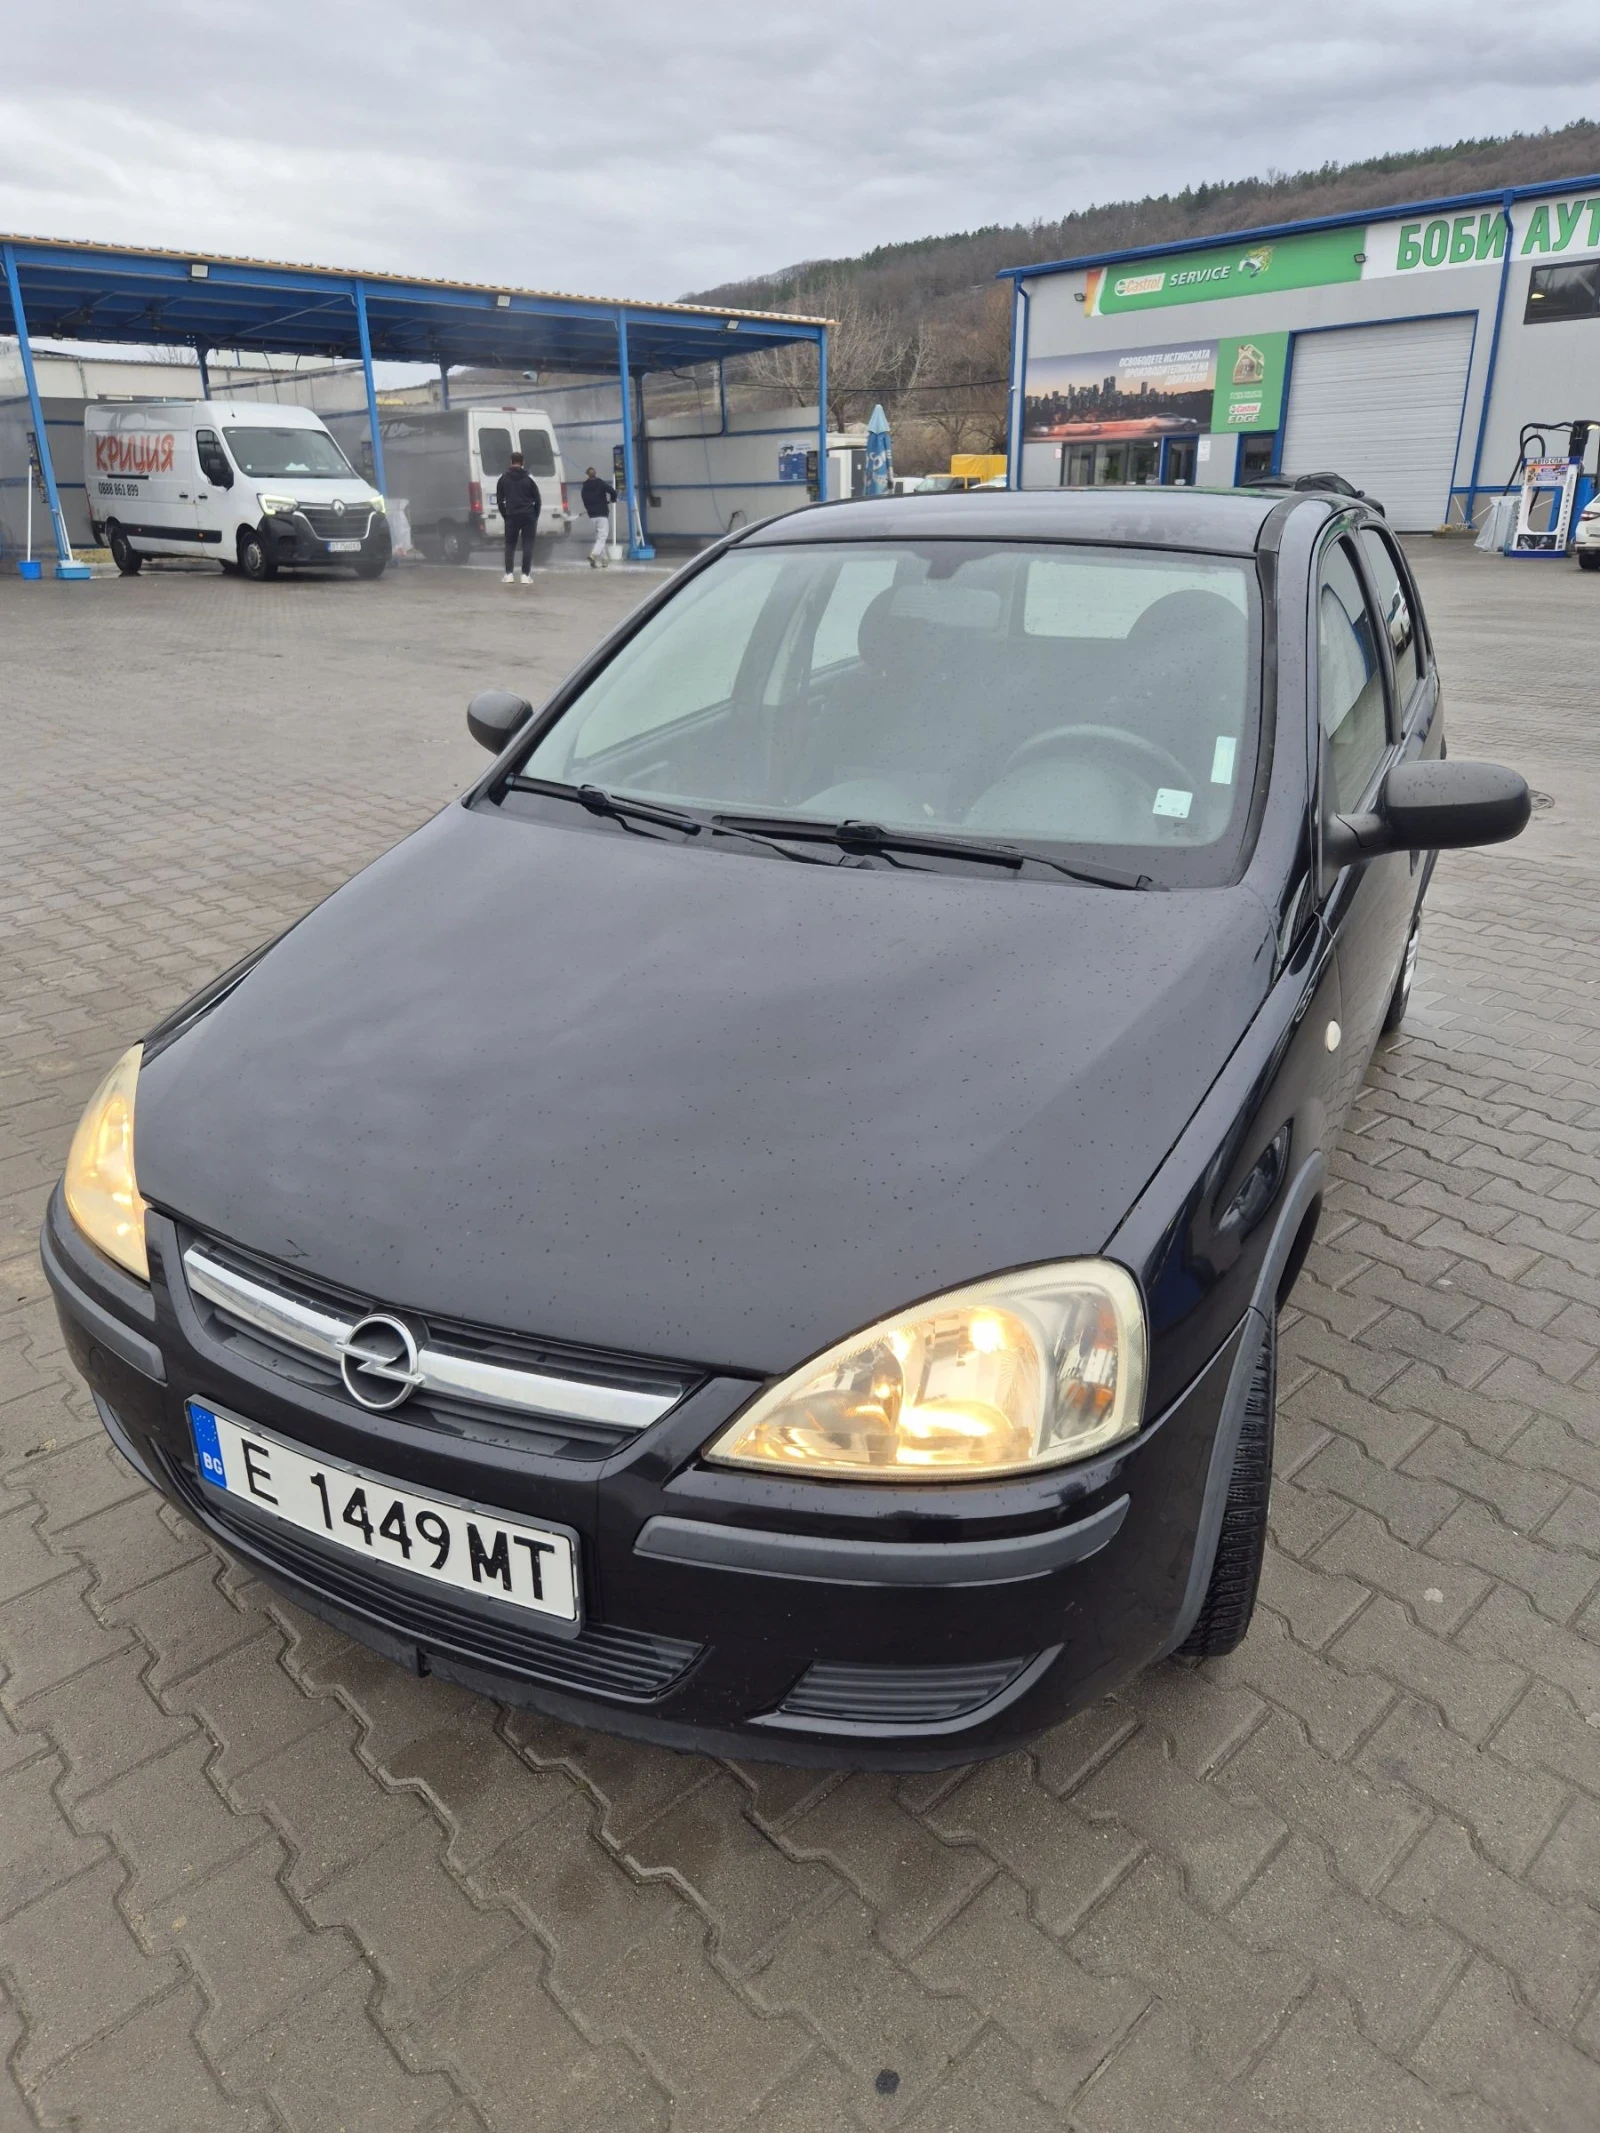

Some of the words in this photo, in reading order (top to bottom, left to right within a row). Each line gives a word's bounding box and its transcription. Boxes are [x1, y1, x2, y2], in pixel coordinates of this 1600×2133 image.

[1396, 212, 1508, 270] БОБИ
[1126, 276, 1161, 293] Castrol
[1169, 266, 1232, 287] SERVICE
[1119, 354, 1164, 368] ОСВОБОДЕТЕ
[1164, 349, 1211, 364] ИСТИНСКАТА
[1227, 414, 1259, 424] EDGE
[1236, 404, 1259, 413] Castrol
[96, 433, 174, 475] КРИЦИЯ
[98, 482, 114, 495] 0888
[114, 483, 126, 496] 861
[127, 484, 139, 497] 899
[202, 1452, 223, 1476] BG
[242, 1438, 278, 1506] E
[310, 1472, 451, 1570] 1449
[466, 1521, 555, 1600] MT
